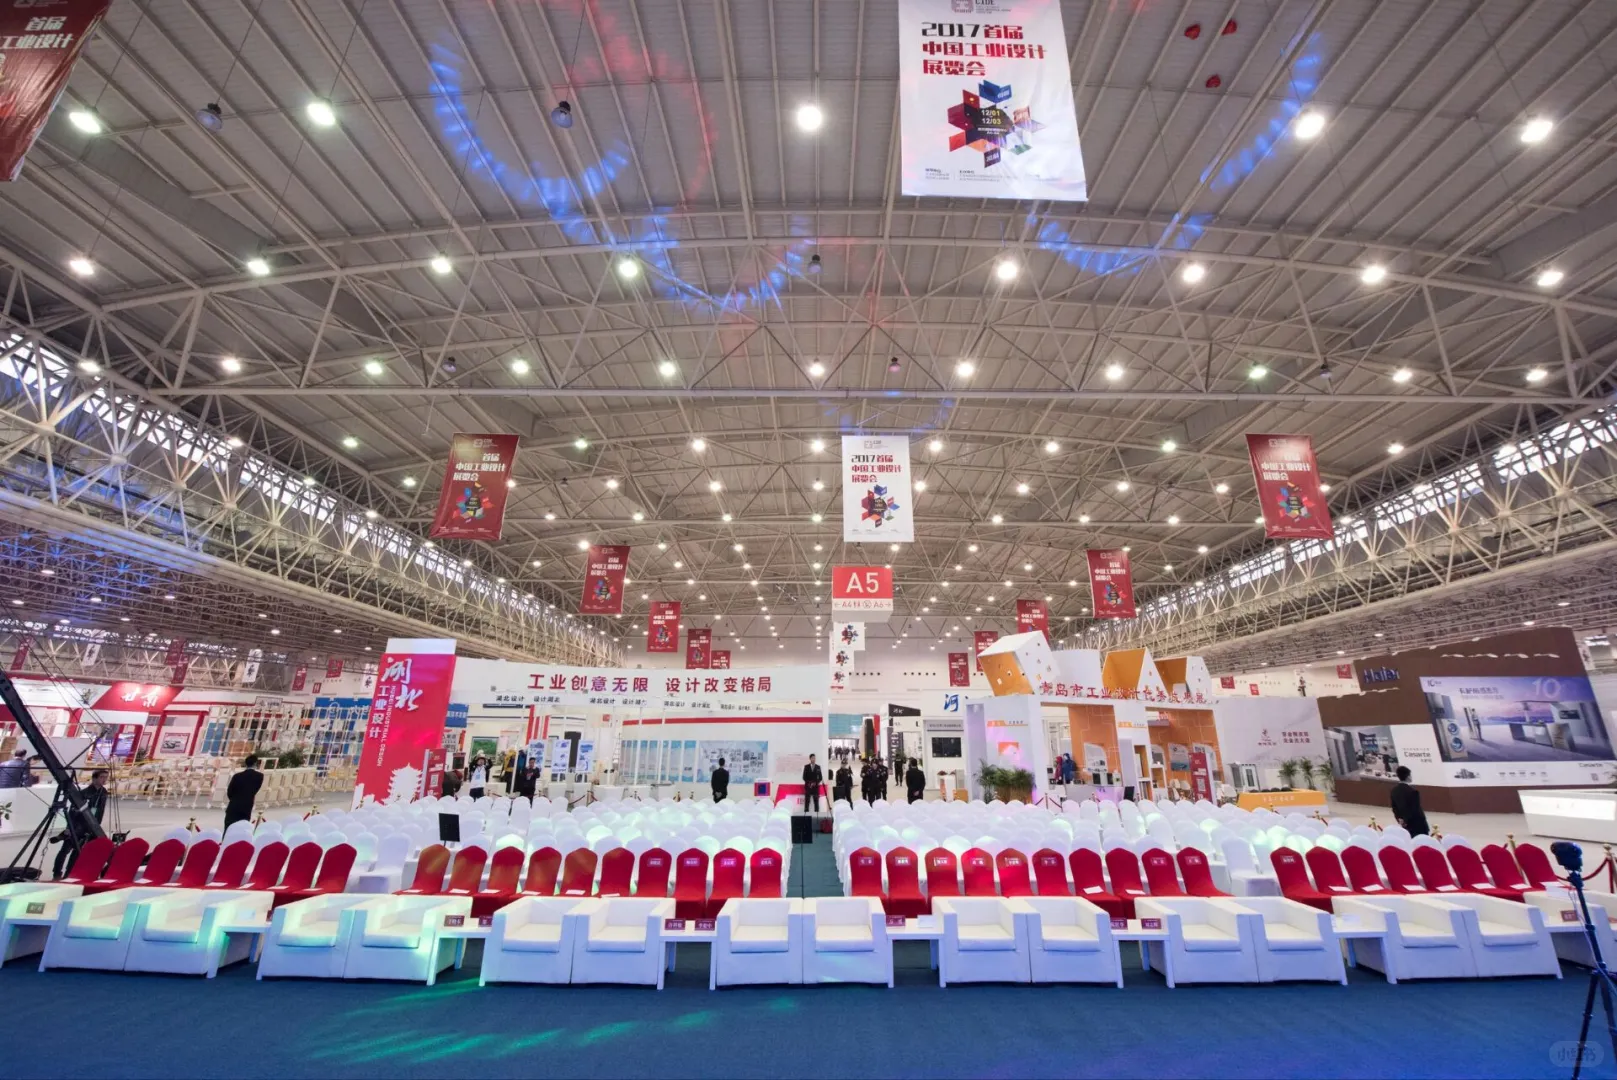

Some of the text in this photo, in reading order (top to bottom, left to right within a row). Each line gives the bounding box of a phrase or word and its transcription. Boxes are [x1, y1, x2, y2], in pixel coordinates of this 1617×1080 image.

[25, 16, 67, 31] 首届
[922, 22, 1023, 39] 2017首届
[1, 33, 73, 49] 工业设计
[922, 41, 1047, 59] 中国工业设计
[923, 60, 985, 76] 展览会
[456, 462, 506, 472] 中国工业设计
[851, 455, 893, 463] 2017首届
[851, 465, 902, 473] 中国工业设计
[846, 572, 879, 593] A5
[528, 673, 772, 693] 工业创意无限 设计改变格局
[1363, 666, 1400, 684] Haier
[1532, 677, 1561, 698] 10
[369, 684, 391, 739] 工业设计
